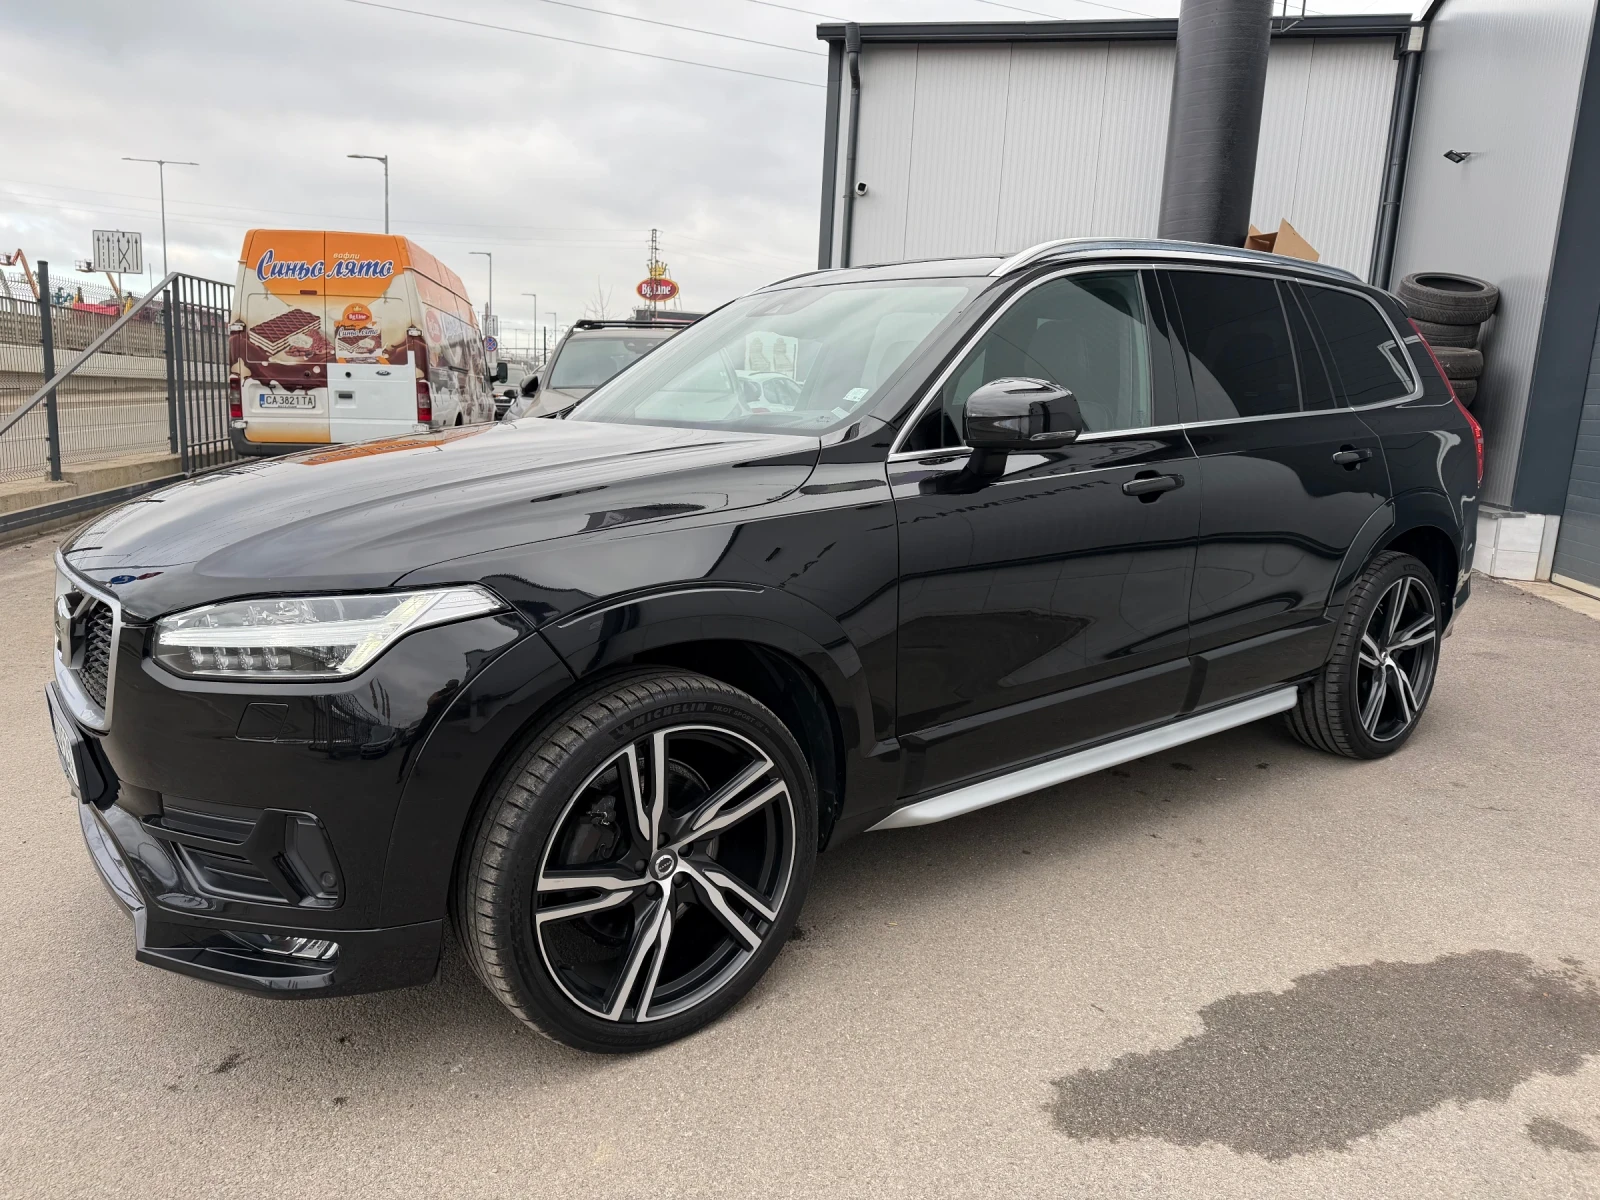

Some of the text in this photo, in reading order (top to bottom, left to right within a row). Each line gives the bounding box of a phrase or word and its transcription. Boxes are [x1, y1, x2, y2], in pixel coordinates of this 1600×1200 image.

[333, 252, 360, 260] вафли
[256, 249, 394, 281] Синьо лято
[266, 396, 313, 405] CA 3821 TA
[633, 703, 755, 727] MICHELIN PILOT SPORT
